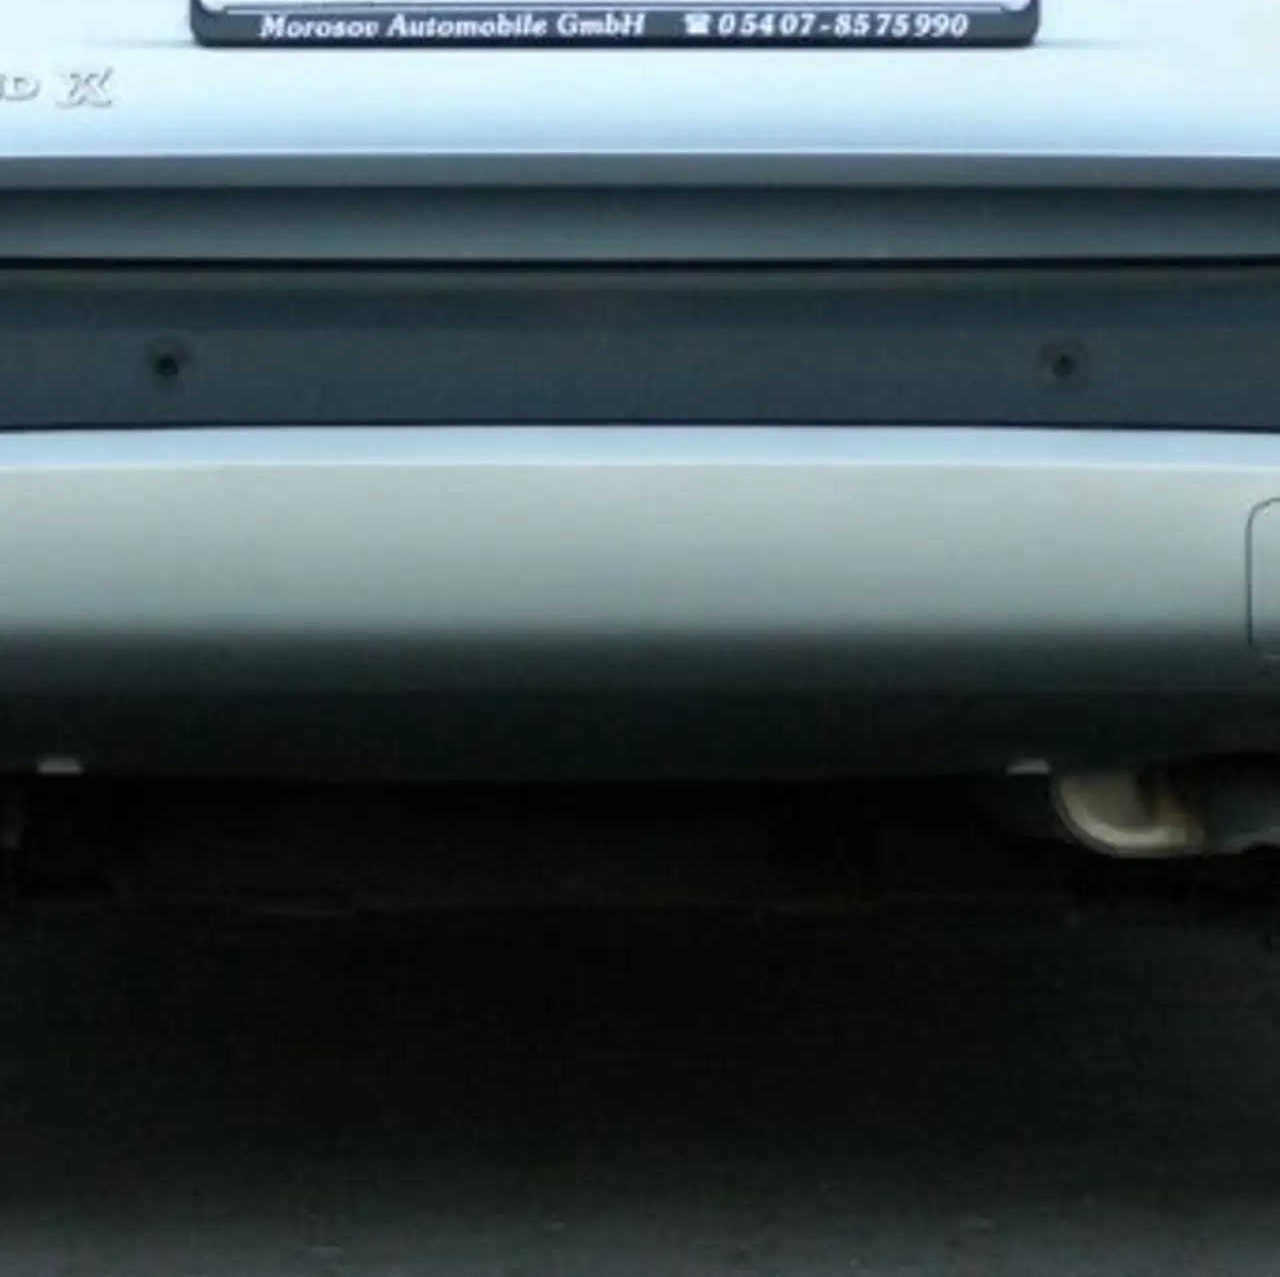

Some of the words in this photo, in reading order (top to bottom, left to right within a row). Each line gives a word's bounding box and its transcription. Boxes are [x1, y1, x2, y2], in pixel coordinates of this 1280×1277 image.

[259, 14, 380, 41] Morosov
[386, 13, 552, 41] Automobile
[557, 13, 649, 40] GmbH
[53, 65, 117, 110] X
